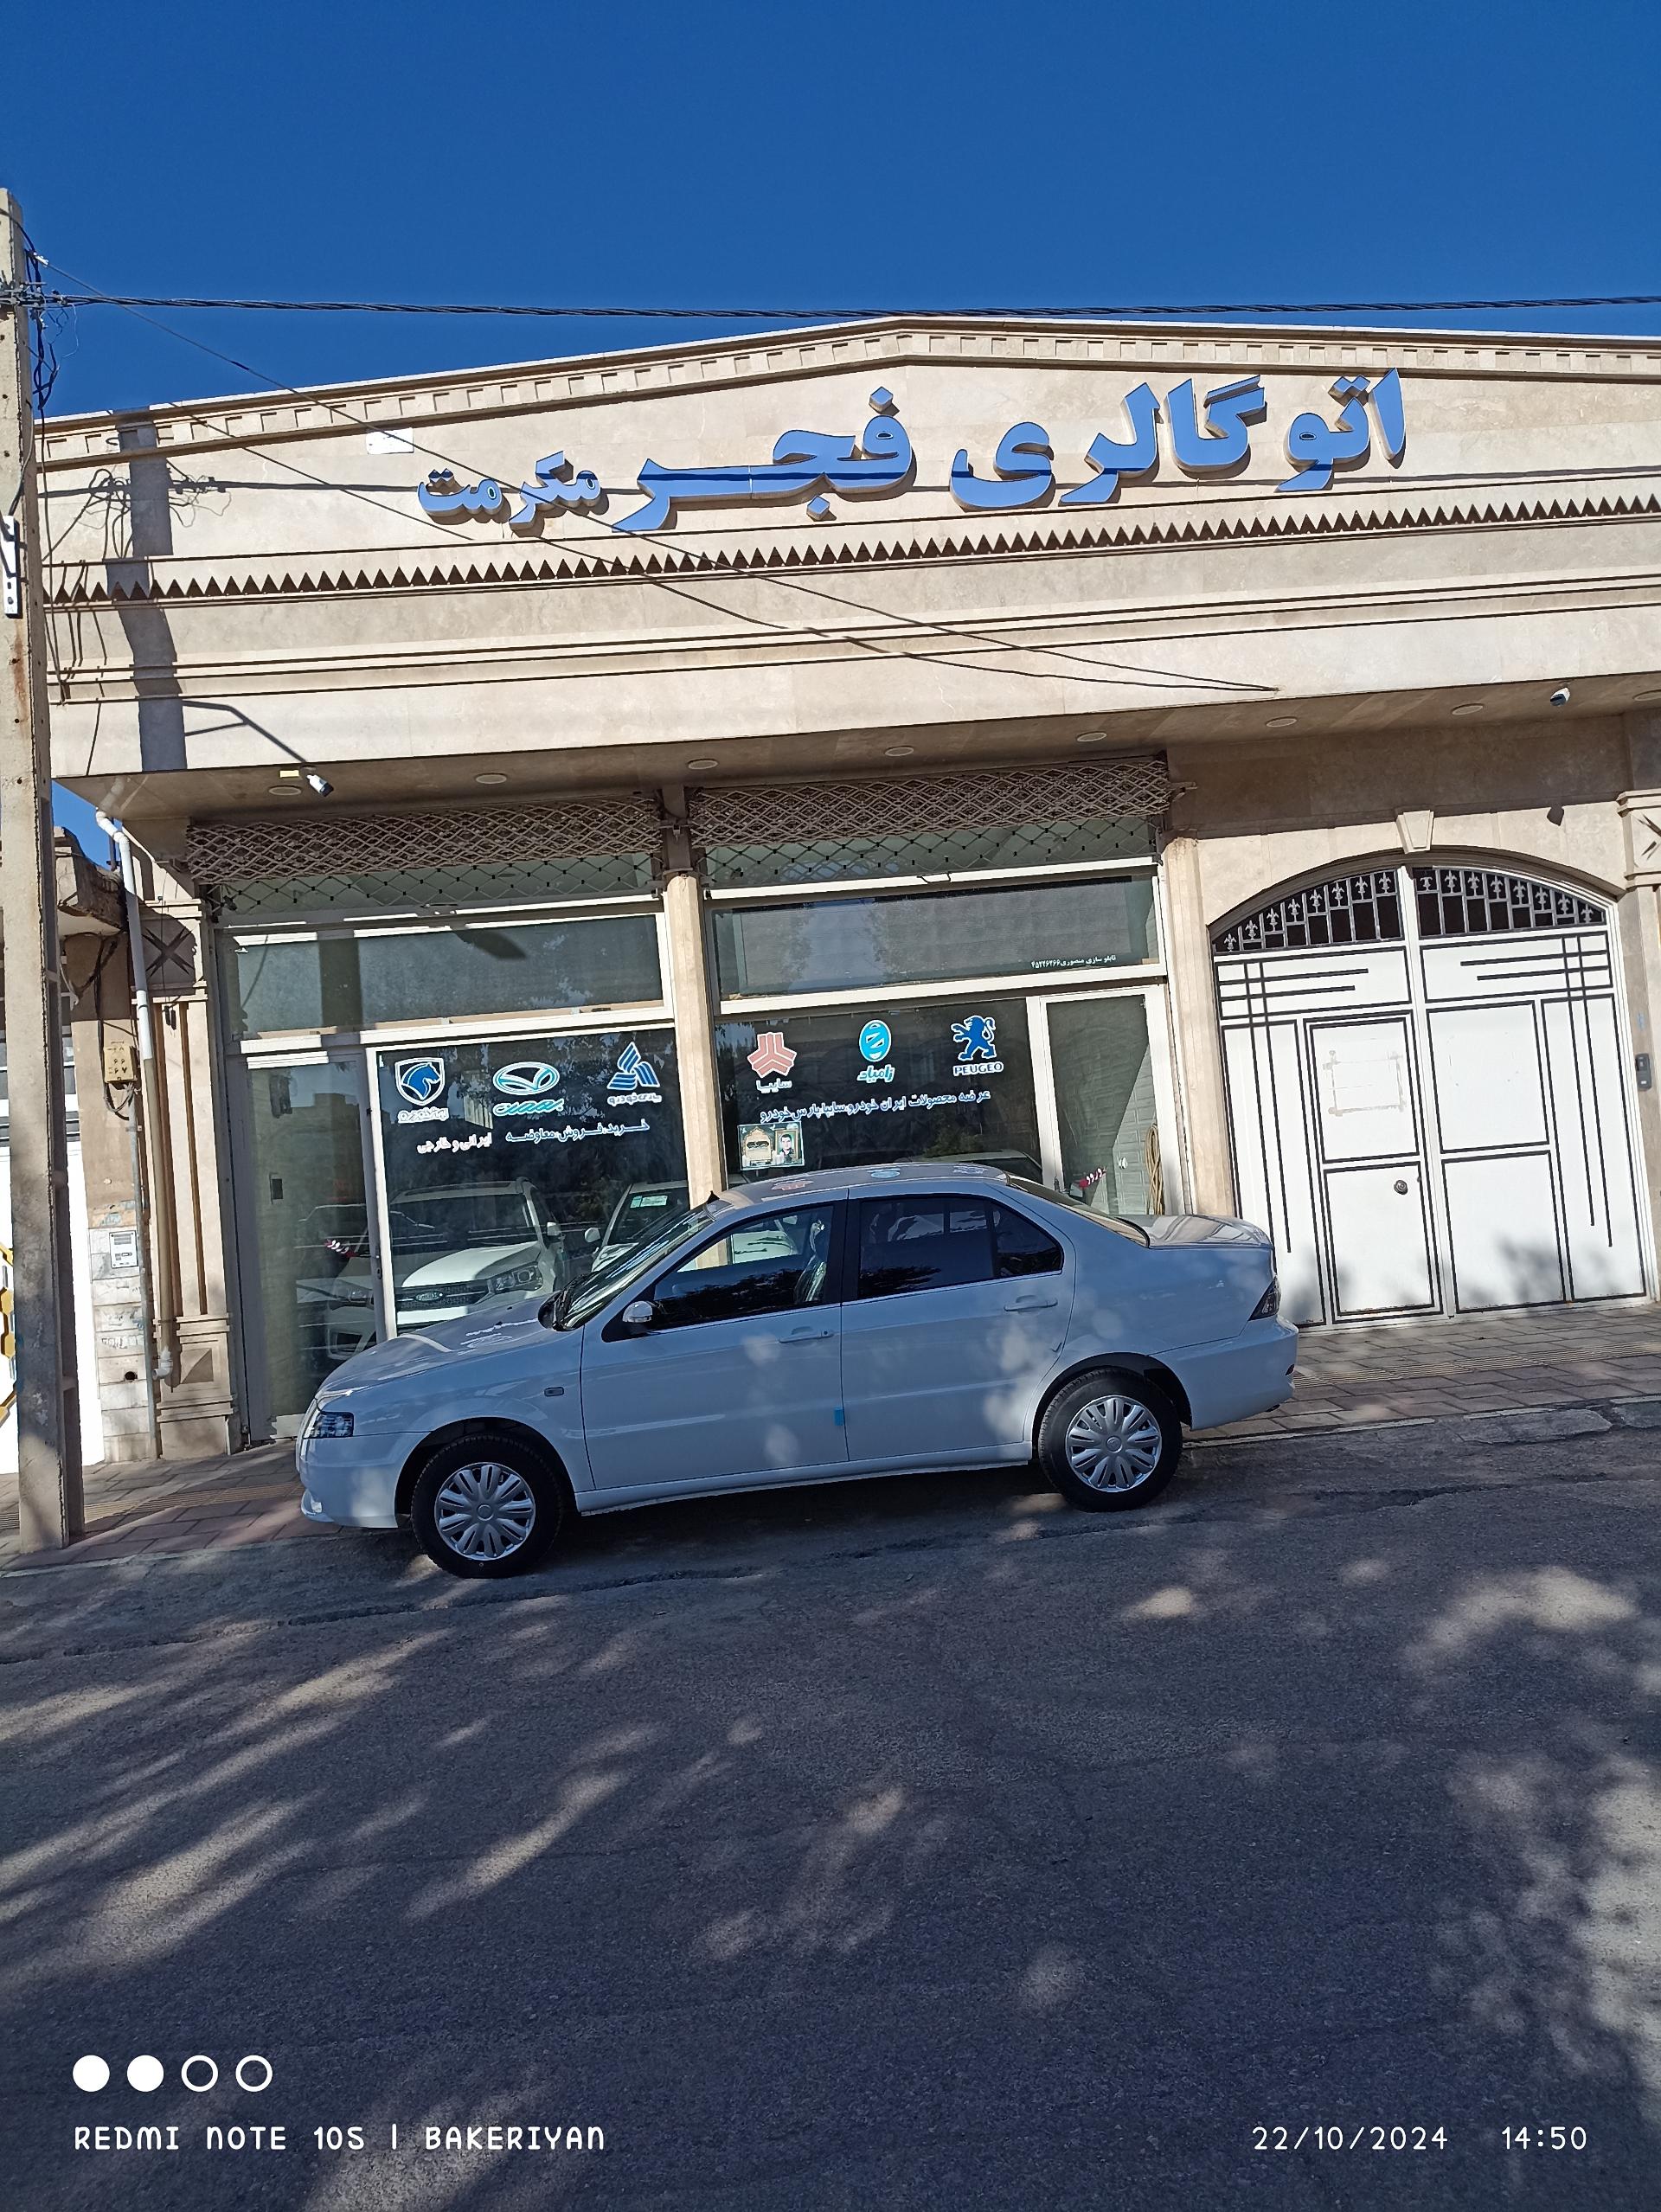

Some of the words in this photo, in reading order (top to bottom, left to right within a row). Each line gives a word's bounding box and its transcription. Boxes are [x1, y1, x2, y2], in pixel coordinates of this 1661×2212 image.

[1276, 368, 1407, 492] اتو
[951, 375, 1266, 509] گالری
[612, 387, 914, 533] فجر
[418, 450, 602, 529] مکرمت
[953, 1061, 1004, 1077] PEUGEO
[756, 1078, 792, 1094] سایپا
[880, 1095, 907, 1112] ایران
[908, 1093, 958, 1110] محصولات
[959, 1090, 991, 1104] عرضه
[760, 1106, 792, 1124] خودرو
[460, 1132, 492, 1151] ایرانی
[505, 1127, 556, 1144] معاوضه
